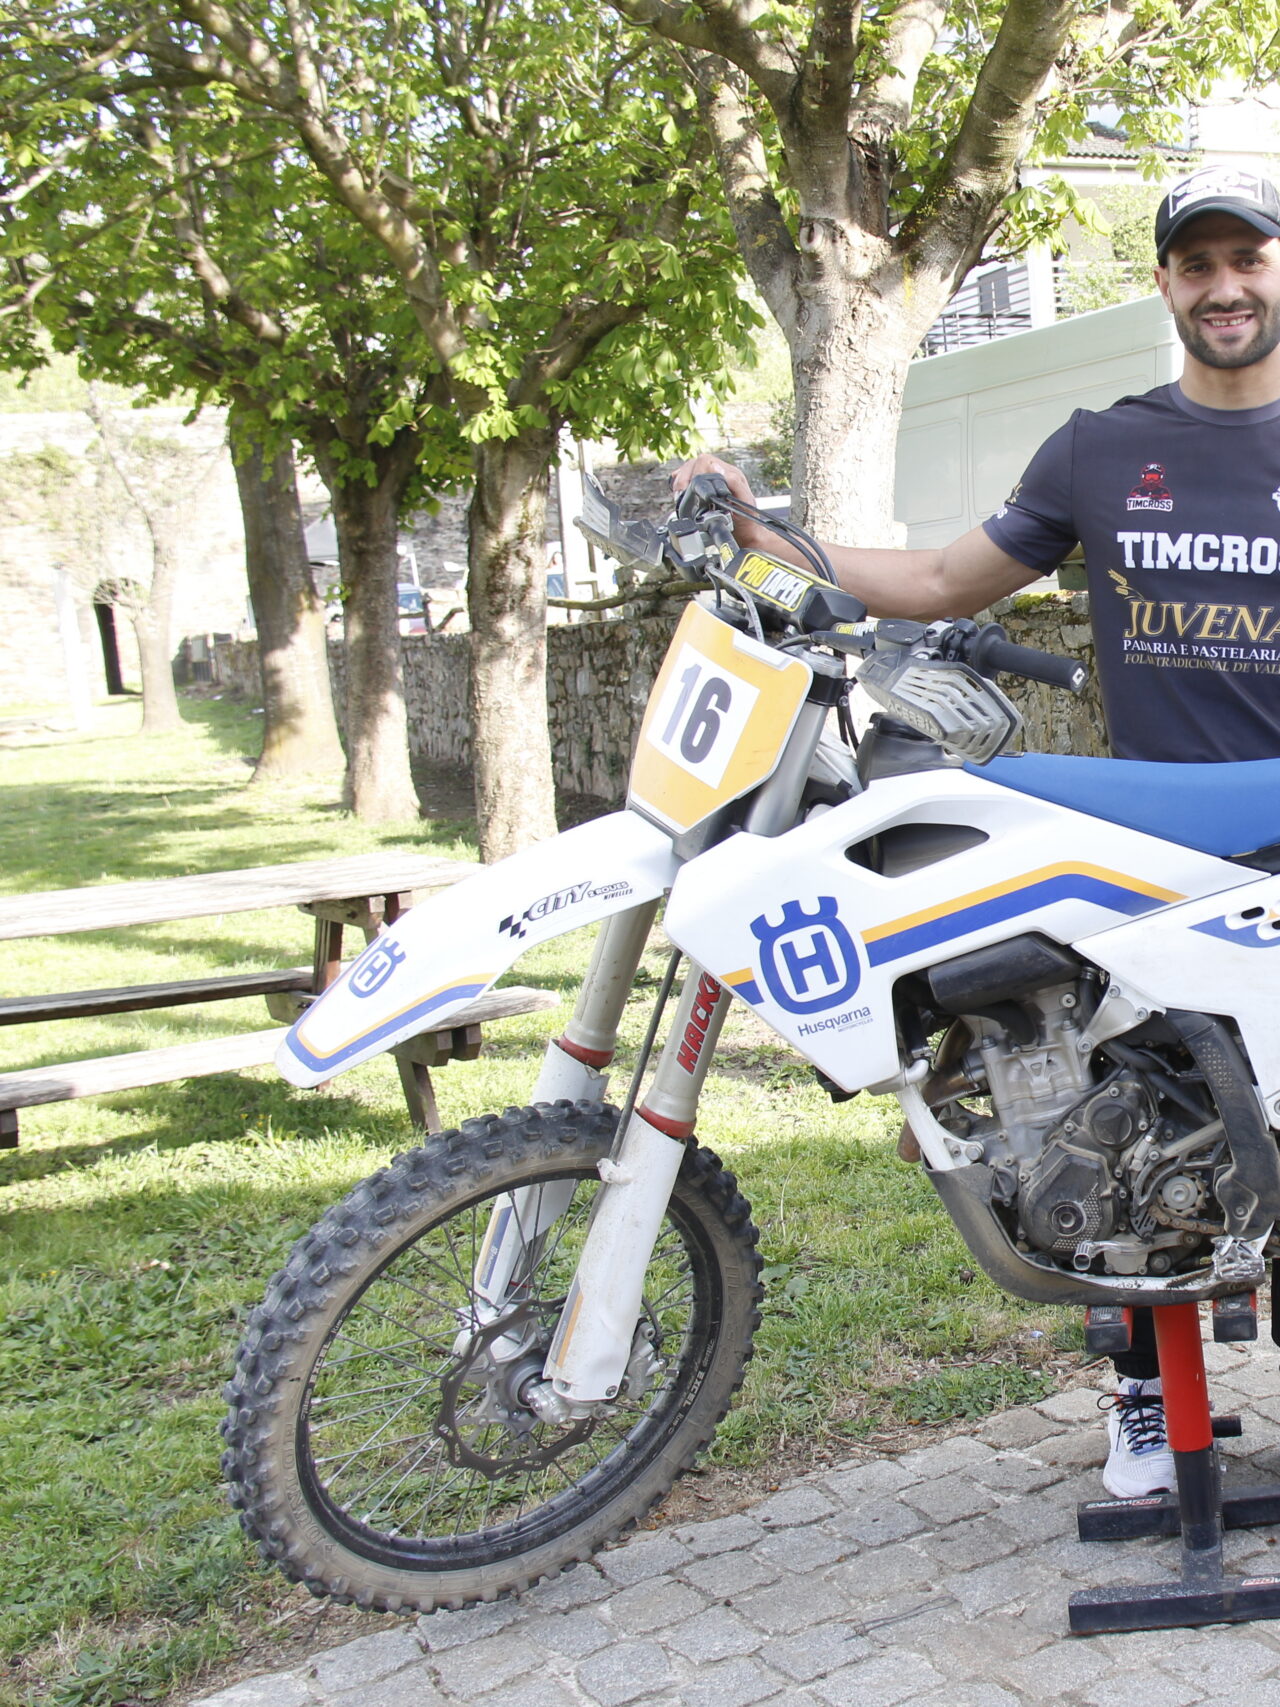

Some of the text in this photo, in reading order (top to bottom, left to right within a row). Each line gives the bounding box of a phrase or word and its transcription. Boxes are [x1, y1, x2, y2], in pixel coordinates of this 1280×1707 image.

[1127, 499, 1172, 511] TIMCROSS
[1123, 639, 1177, 655] PADARIA
[1180, 644, 1189, 656] E
[1153, 656, 1230, 672] TRADICIONAL
[1232, 662, 1250, 673] DE
[661, 663, 732, 764] 16
[528, 880, 592, 921] CITY
[797, 1006, 871, 1037] Husqvarna
[308, 1340, 332, 1383] EXCEL
[682, 1370, 705, 1408] EXCEL
